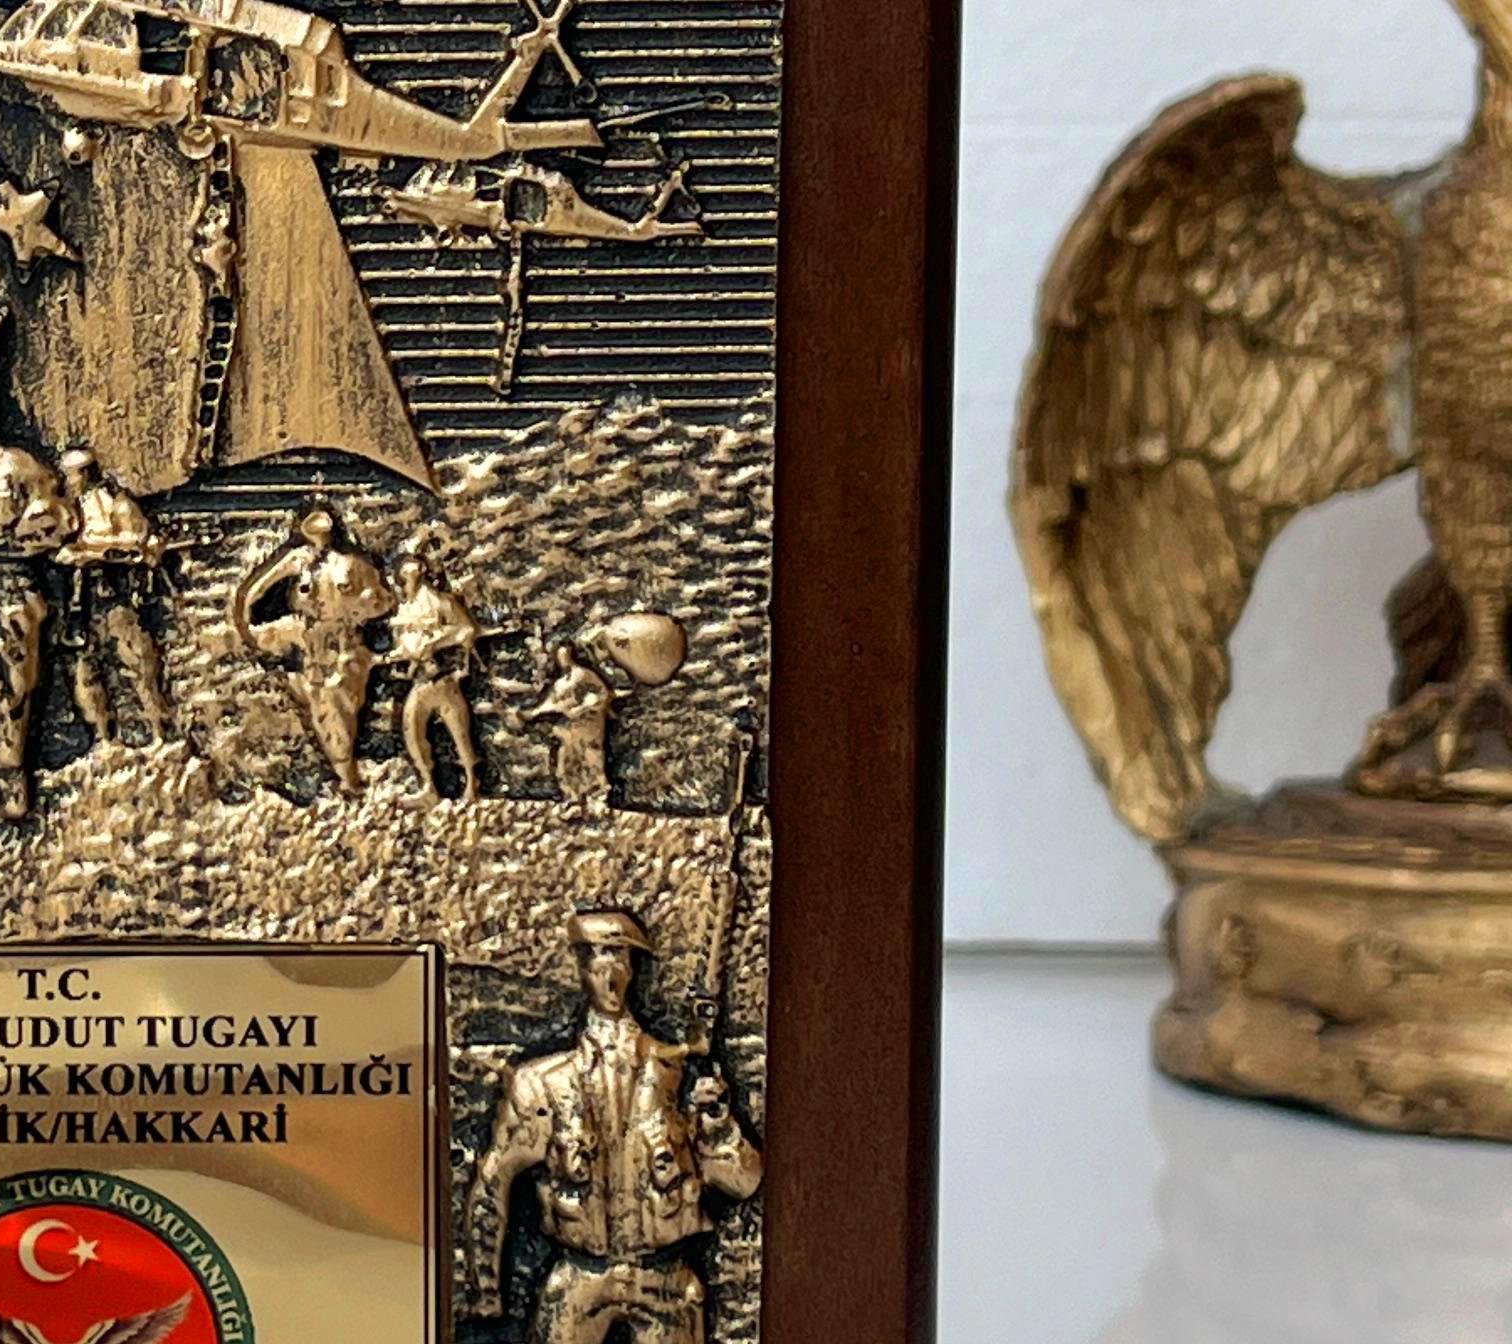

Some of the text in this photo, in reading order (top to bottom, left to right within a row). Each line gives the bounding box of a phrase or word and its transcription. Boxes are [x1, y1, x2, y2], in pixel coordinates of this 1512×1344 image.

[17, 966, 101, 1001] T.C.
[137, 1016, 319, 1049] TUGAYI
[65, 1053, 411, 1097] KOMUTANLIĞI
[11, 1176, 109, 1202] TUGAY
[110, 1185, 248, 1343] KOMUTANLIĞI
